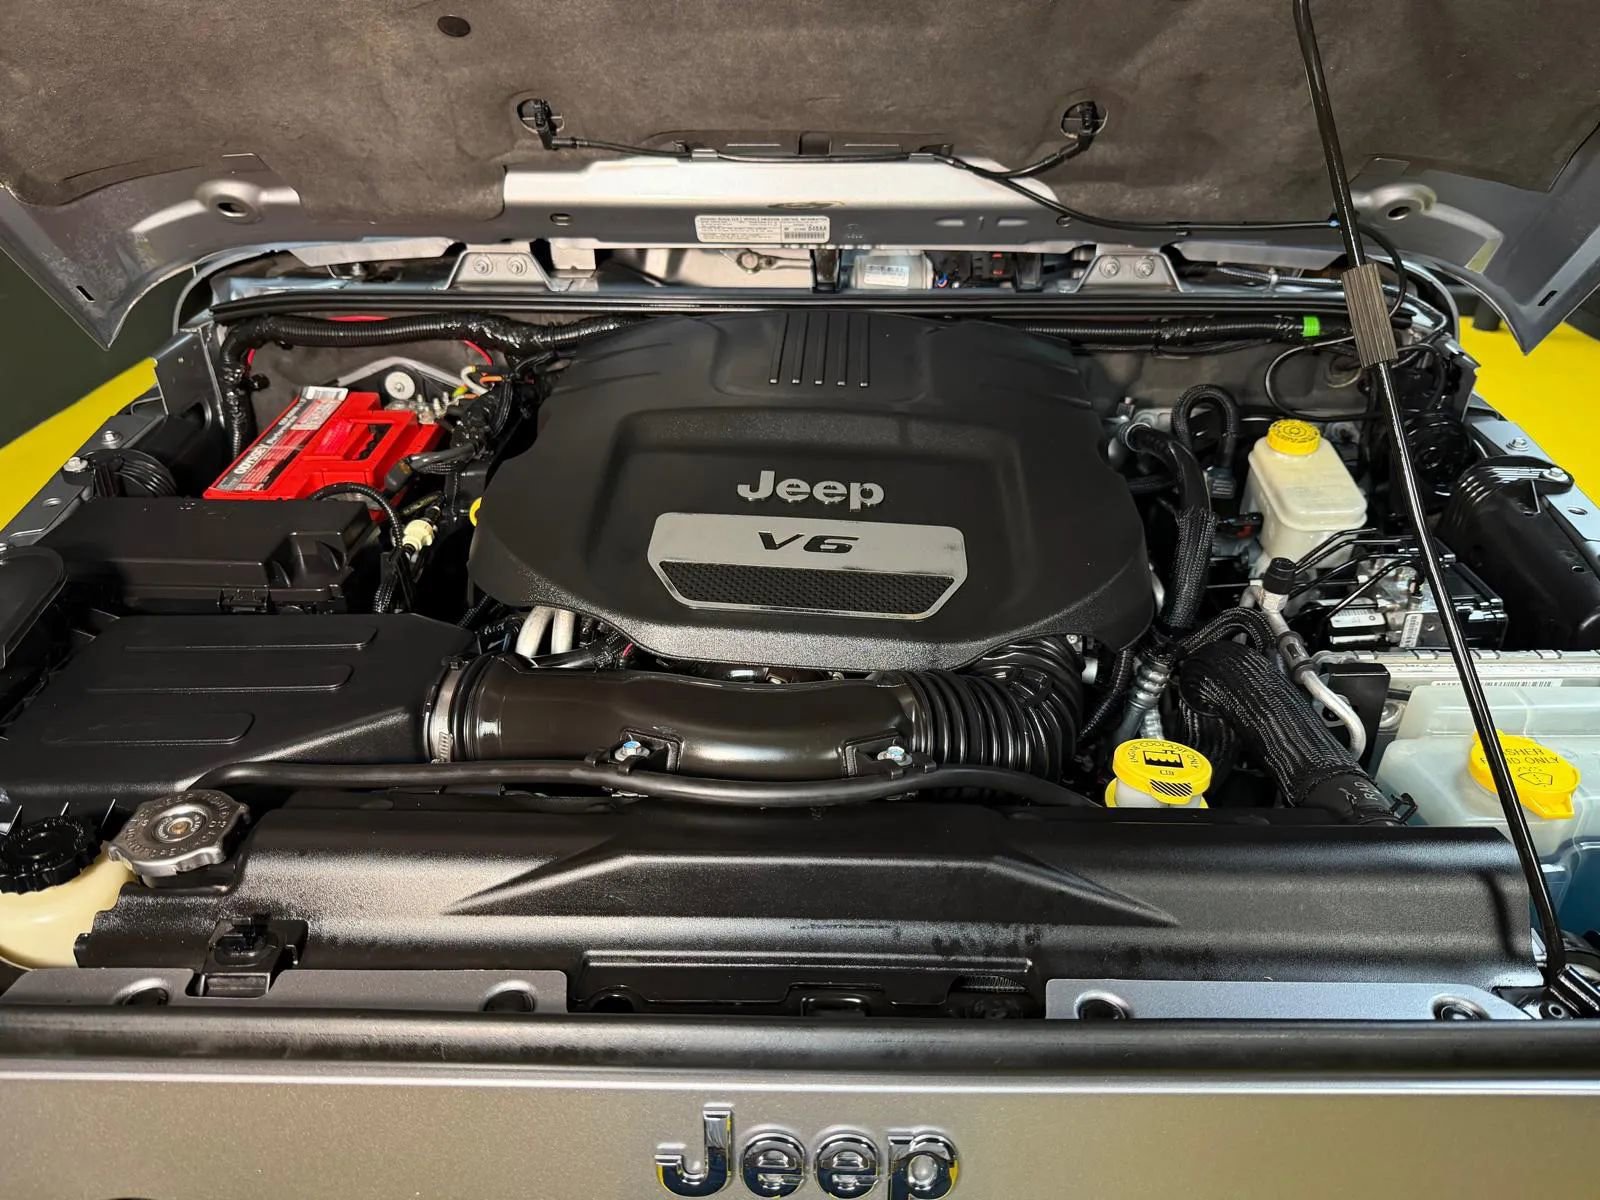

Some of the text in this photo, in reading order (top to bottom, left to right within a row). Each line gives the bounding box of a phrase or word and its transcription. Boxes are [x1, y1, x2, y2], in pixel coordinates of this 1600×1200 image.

[233, 443, 270, 475] ODYSSEY
[736, 469, 885, 512] Jeep
[758, 530, 860, 554] V6
[1139, 741, 1186, 754] COOLANT
[1503, 748, 1545, 756] SHER
[1524, 756, 1559, 765] ONLY
[655, 1102, 959, 1200] Jeep
